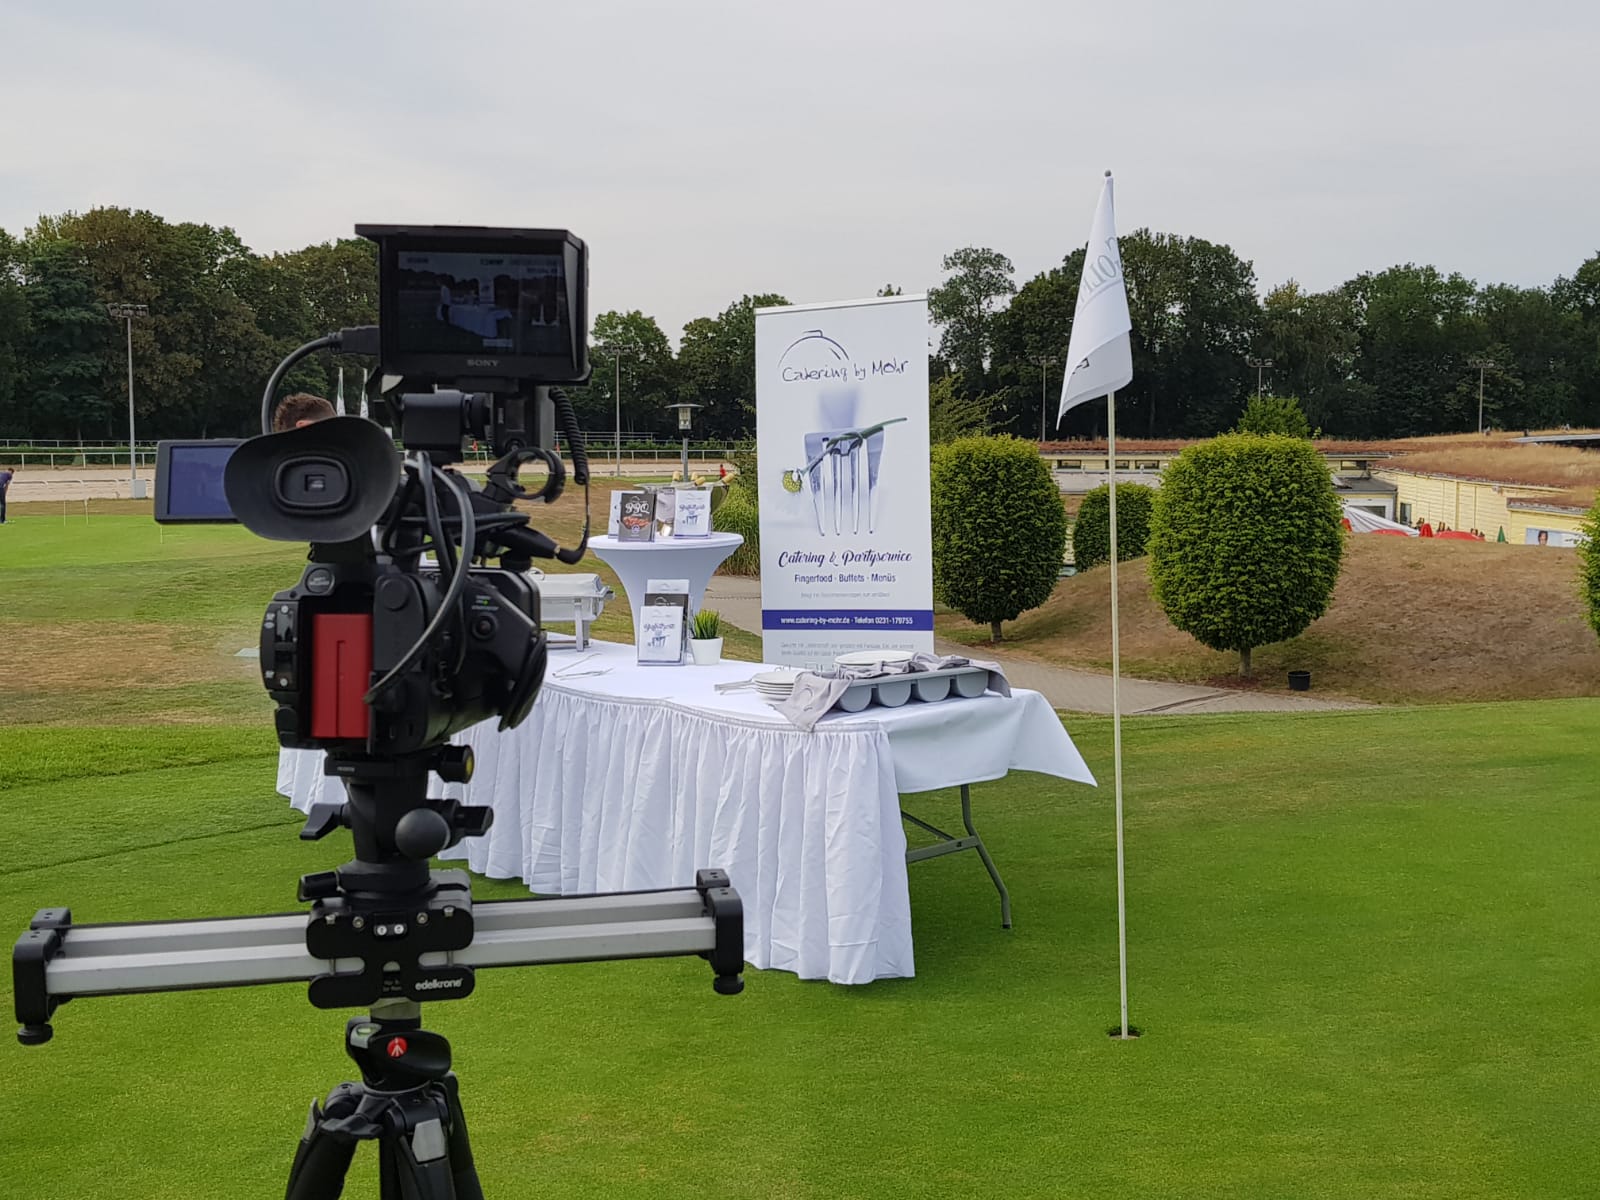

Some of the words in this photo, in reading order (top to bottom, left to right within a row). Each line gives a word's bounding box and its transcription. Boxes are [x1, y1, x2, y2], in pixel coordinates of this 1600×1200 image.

[467, 359, 499, 367] SONY
[782, 363, 848, 382] Catering
[854, 363, 866, 380] by
[778, 550, 825, 567] Catering
[829, 551, 839, 566] &
[841, 548, 913, 567] Partyservice
[794, 574, 833, 584] Fingerfood
[839, 573, 865, 583] Buffets
[871, 573, 897, 583] Menüs
[854, 616, 875, 625] Telefon
[415, 978, 463, 991] edelkrone
